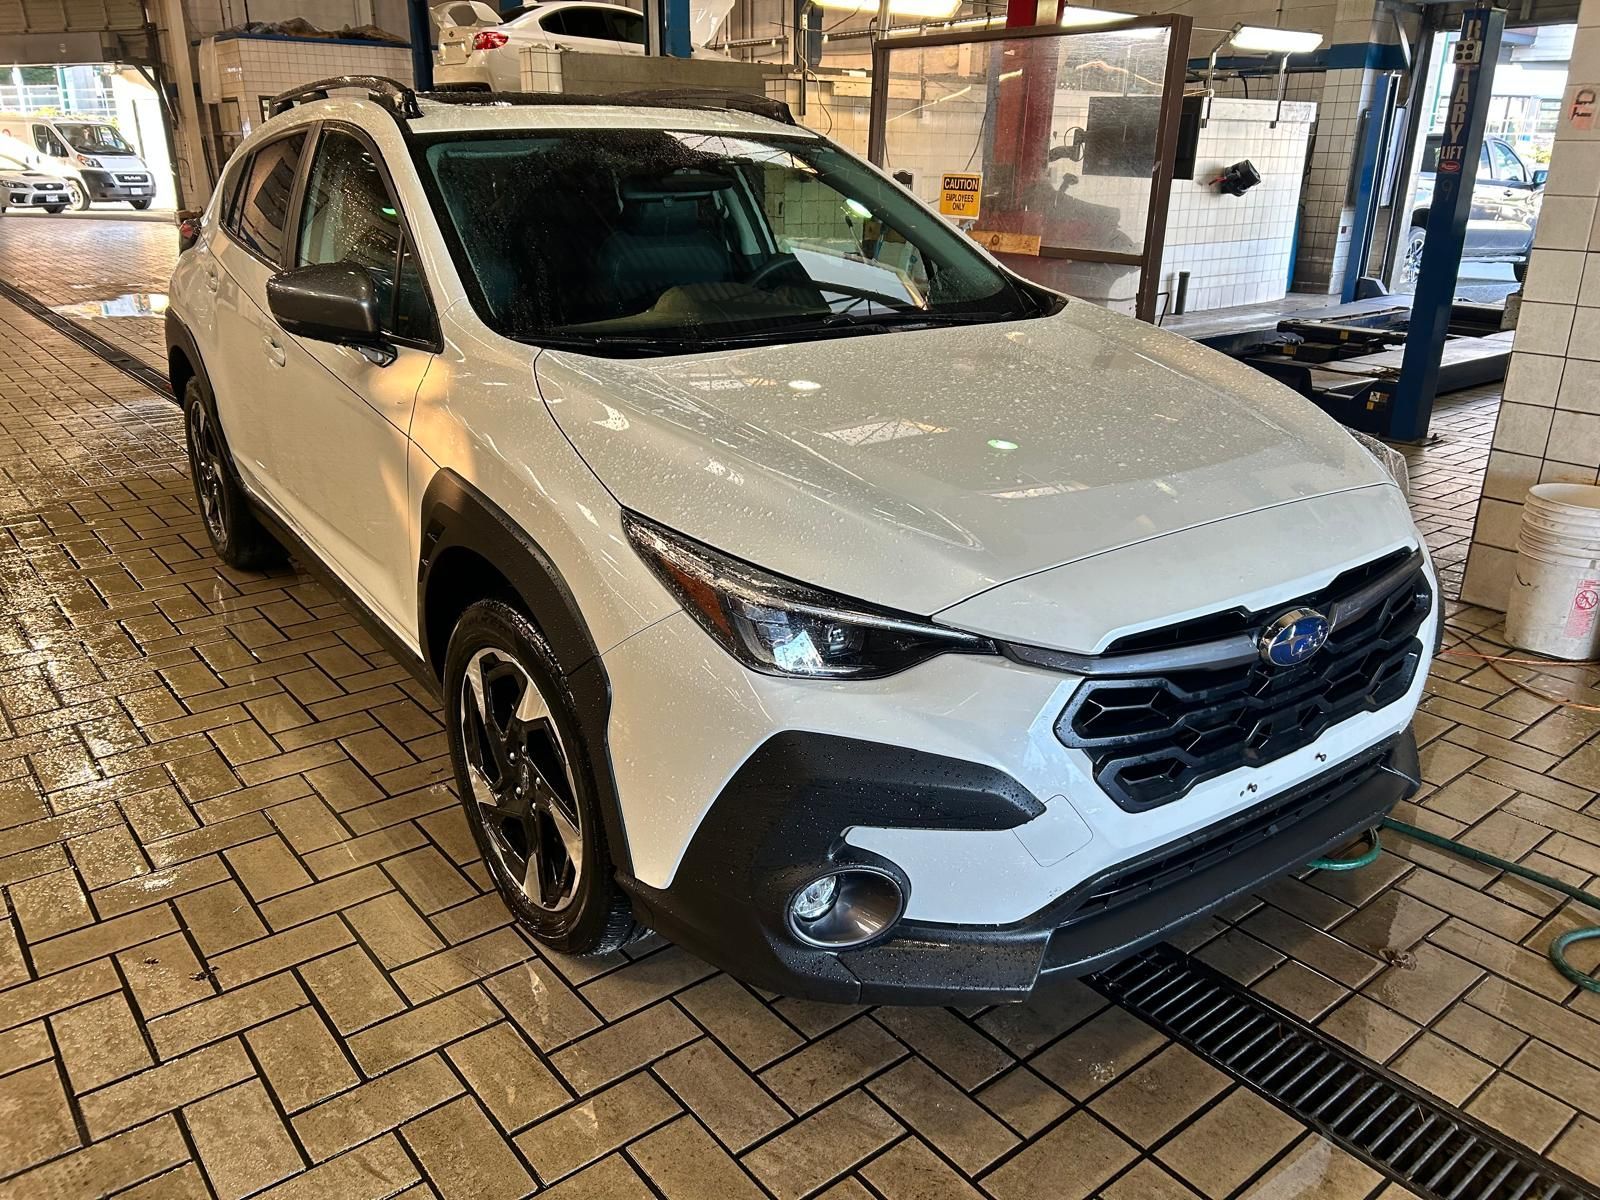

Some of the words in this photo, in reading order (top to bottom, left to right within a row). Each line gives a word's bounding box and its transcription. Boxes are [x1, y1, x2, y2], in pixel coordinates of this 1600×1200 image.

[1450, 19, 1482, 144] RTARY
[1440, 146, 1463, 159] LIFT
[944, 178, 978, 190] CAUTION
[946, 193, 974, 203] EMPLOYEES
[952, 203, 965, 211] ONLY
